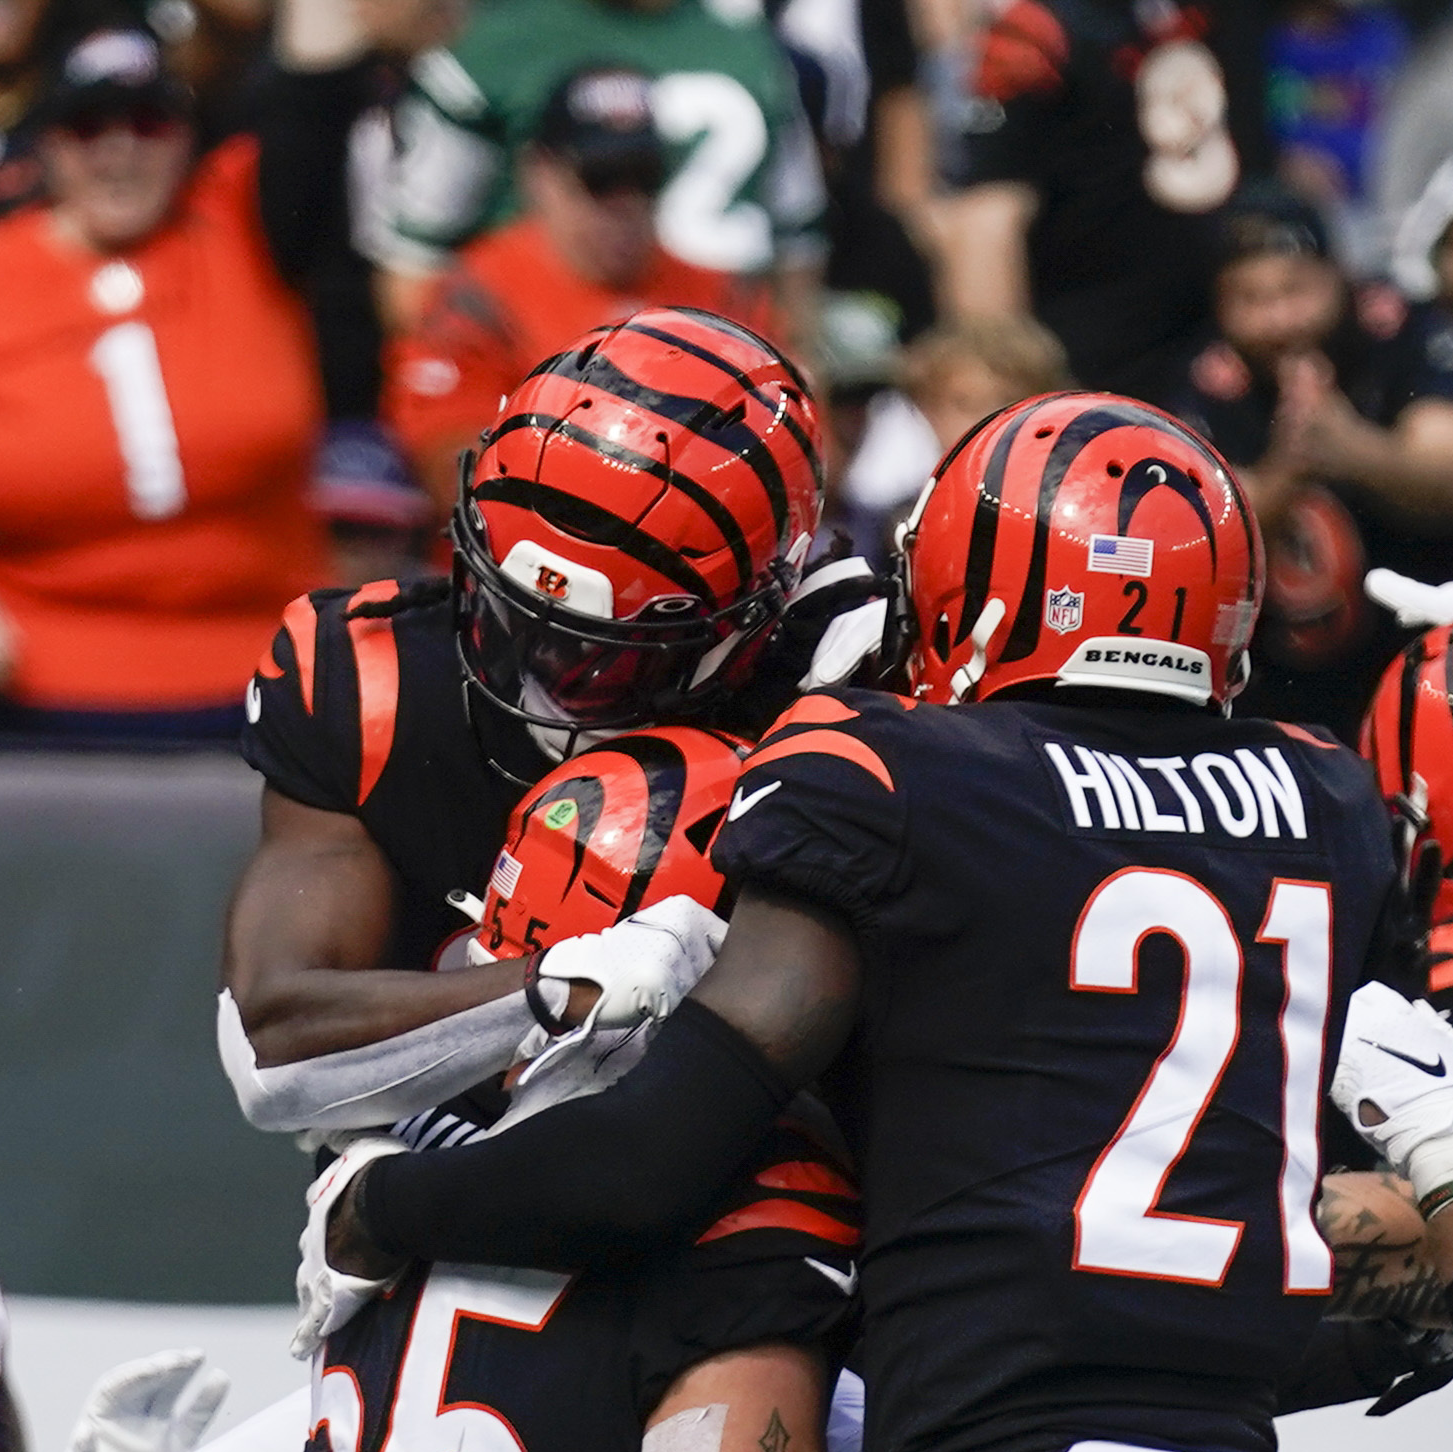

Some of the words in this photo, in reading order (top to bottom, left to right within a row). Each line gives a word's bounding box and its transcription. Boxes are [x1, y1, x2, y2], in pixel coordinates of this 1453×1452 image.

[651, 71, 773, 271] 2
[88, 320, 189, 521] 1
[1052, 607, 1077, 627] NFL
[1084, 650, 1204, 675] BENGALS
[1045, 742, 1308, 839] HILTON
[1068, 864, 1336, 1296] 21
